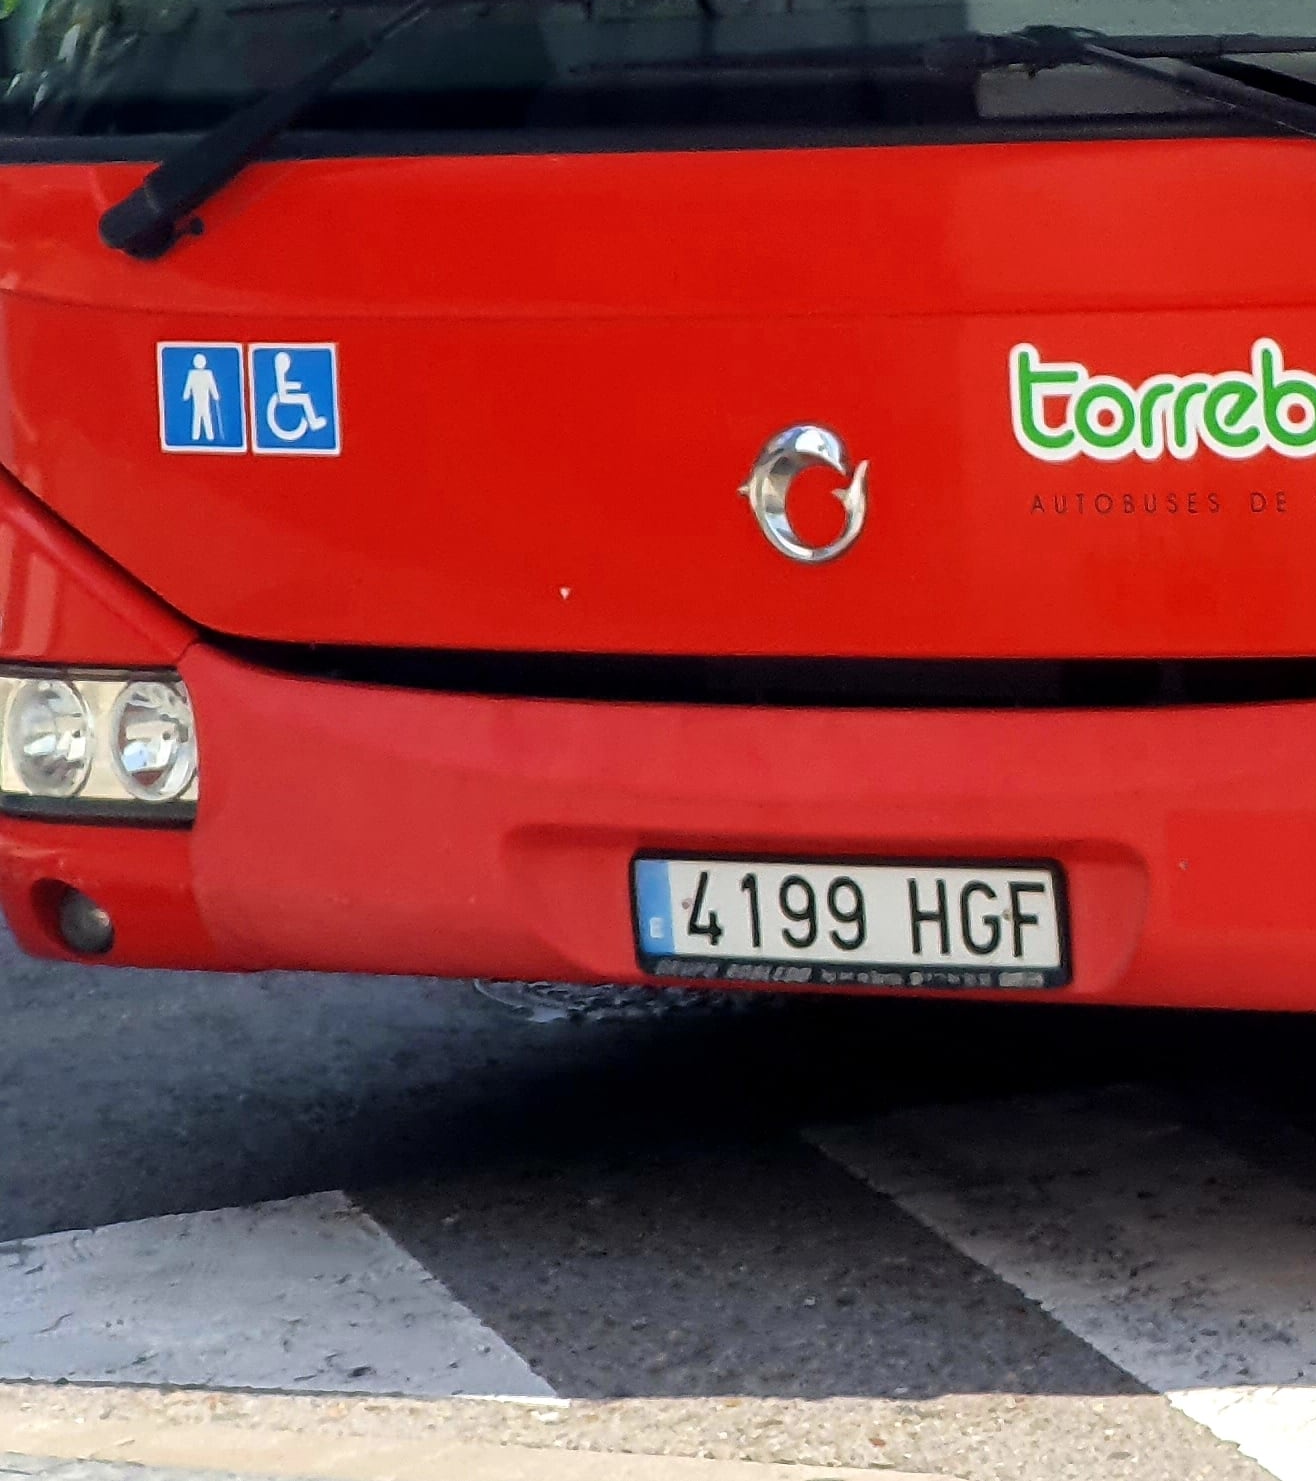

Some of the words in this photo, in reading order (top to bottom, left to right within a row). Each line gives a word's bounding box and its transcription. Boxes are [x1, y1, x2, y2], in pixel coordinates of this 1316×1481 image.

[1031, 490, 1221, 514] AUTOBUSES
[1251, 490, 1287, 514] DE
[687, 871, 867, 951] 4199
[907, 877, 1046, 958] HGF
